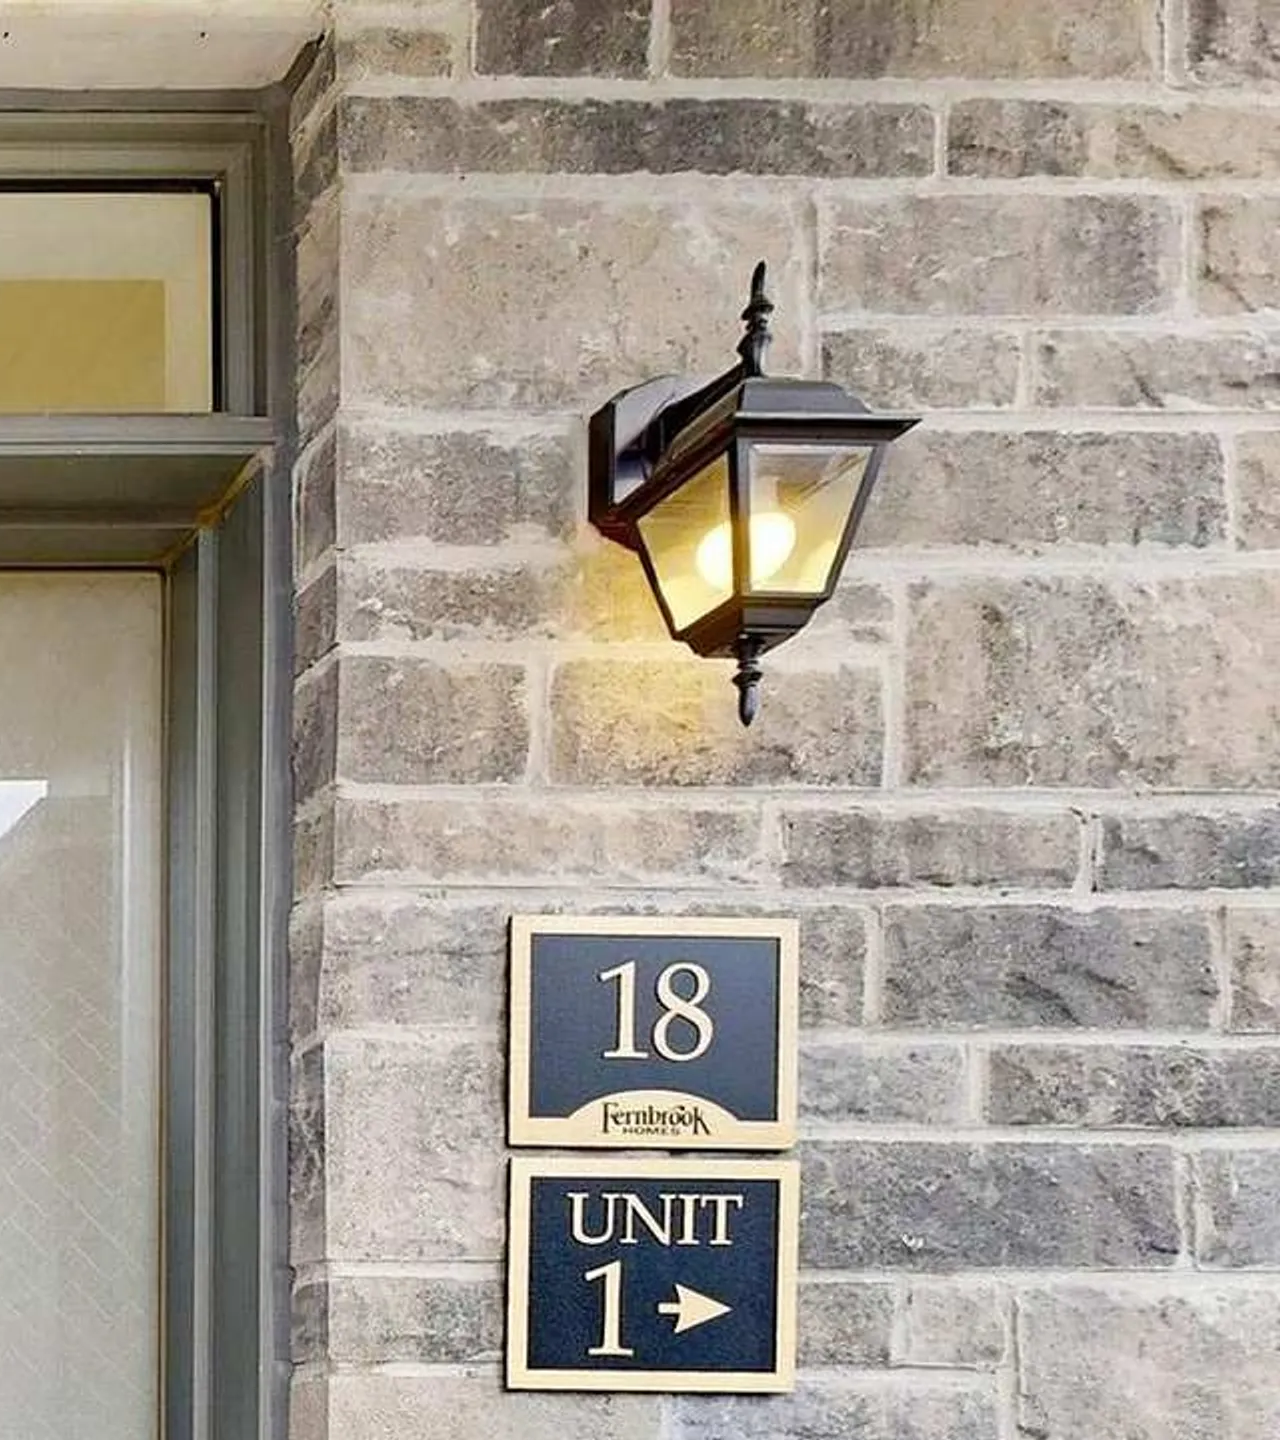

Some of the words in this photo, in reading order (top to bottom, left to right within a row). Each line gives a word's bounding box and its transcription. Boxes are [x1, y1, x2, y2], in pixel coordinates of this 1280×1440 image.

[599, 960, 713, 1061] 18
[602, 1101, 711, 1135] Fernbrook
[622, 1126, 681, 1135] HOMES
[567, 1193, 743, 1246] UNIT
[584, 1260, 634, 1357] 1
